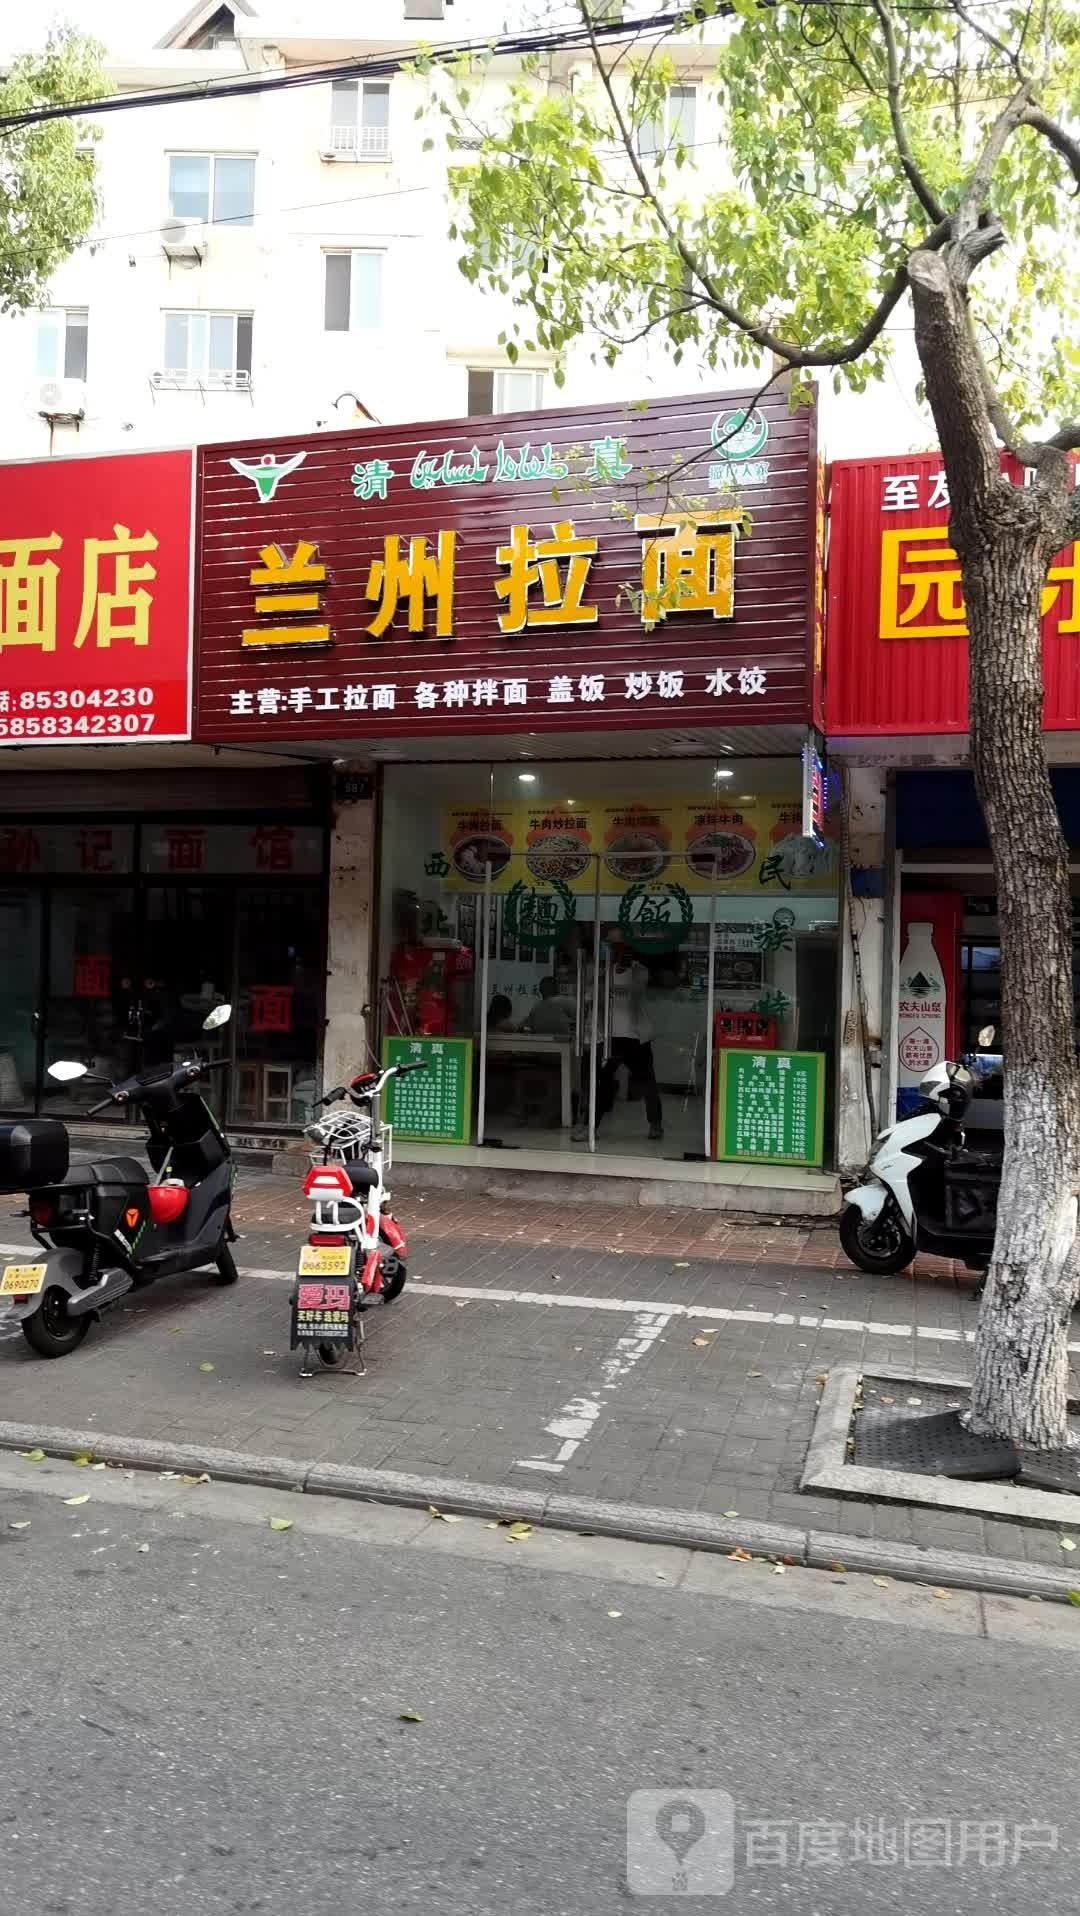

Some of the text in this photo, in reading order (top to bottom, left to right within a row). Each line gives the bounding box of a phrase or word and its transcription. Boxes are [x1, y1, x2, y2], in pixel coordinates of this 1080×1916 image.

[351, 459, 394, 500] 清
[0, 522, 160, 654] 面店
[241, 507, 742, 649] 兰州拉面
[230, 666, 768, 716] 主营:手工拉面 各种拌面 盖饭 炒饭 水饺
[0, 713, 155, 737] 5858342307
[898, 1001, 942, 1013] 农夫山泉
